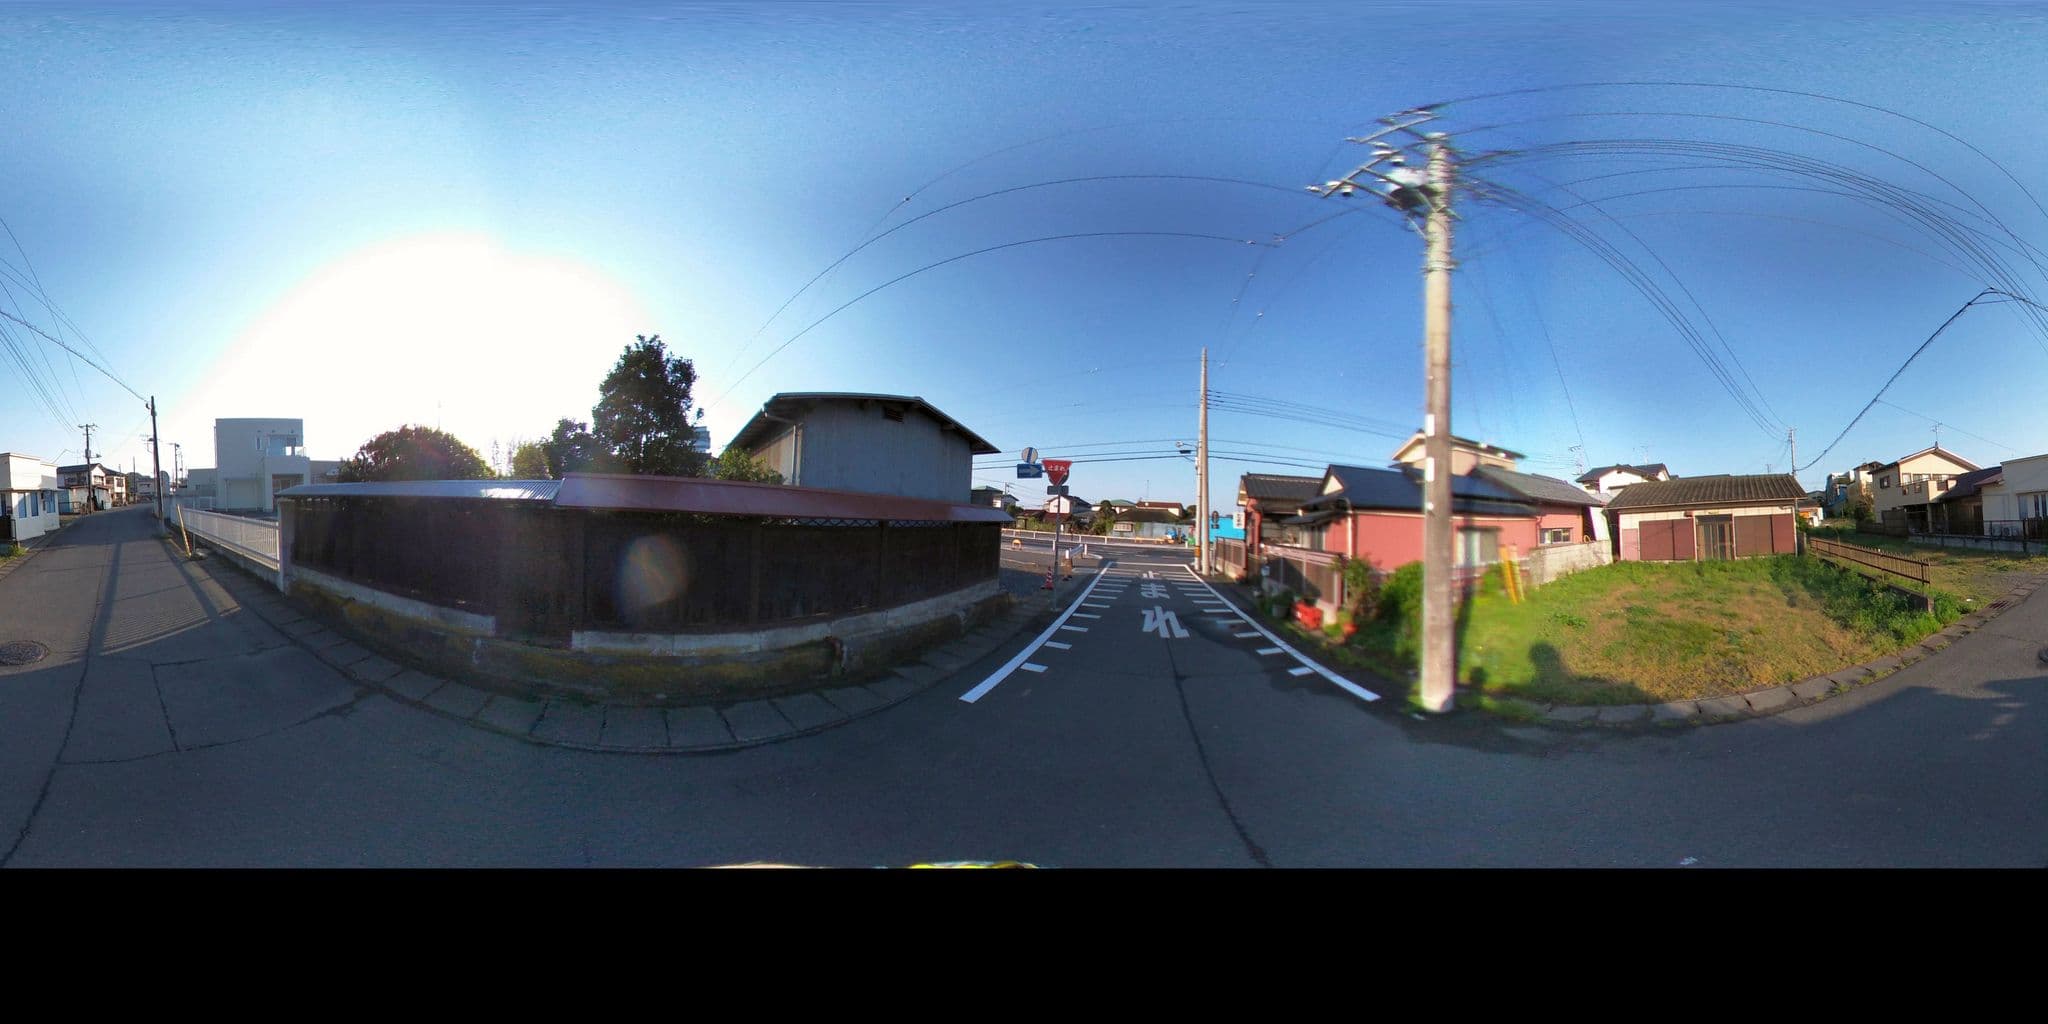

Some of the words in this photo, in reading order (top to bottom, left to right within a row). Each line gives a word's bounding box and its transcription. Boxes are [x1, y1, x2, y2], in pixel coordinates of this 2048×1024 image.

[1047, 464, 1066, 472] 止まれ
[1139, 570, 1190, 638] 止まれ
